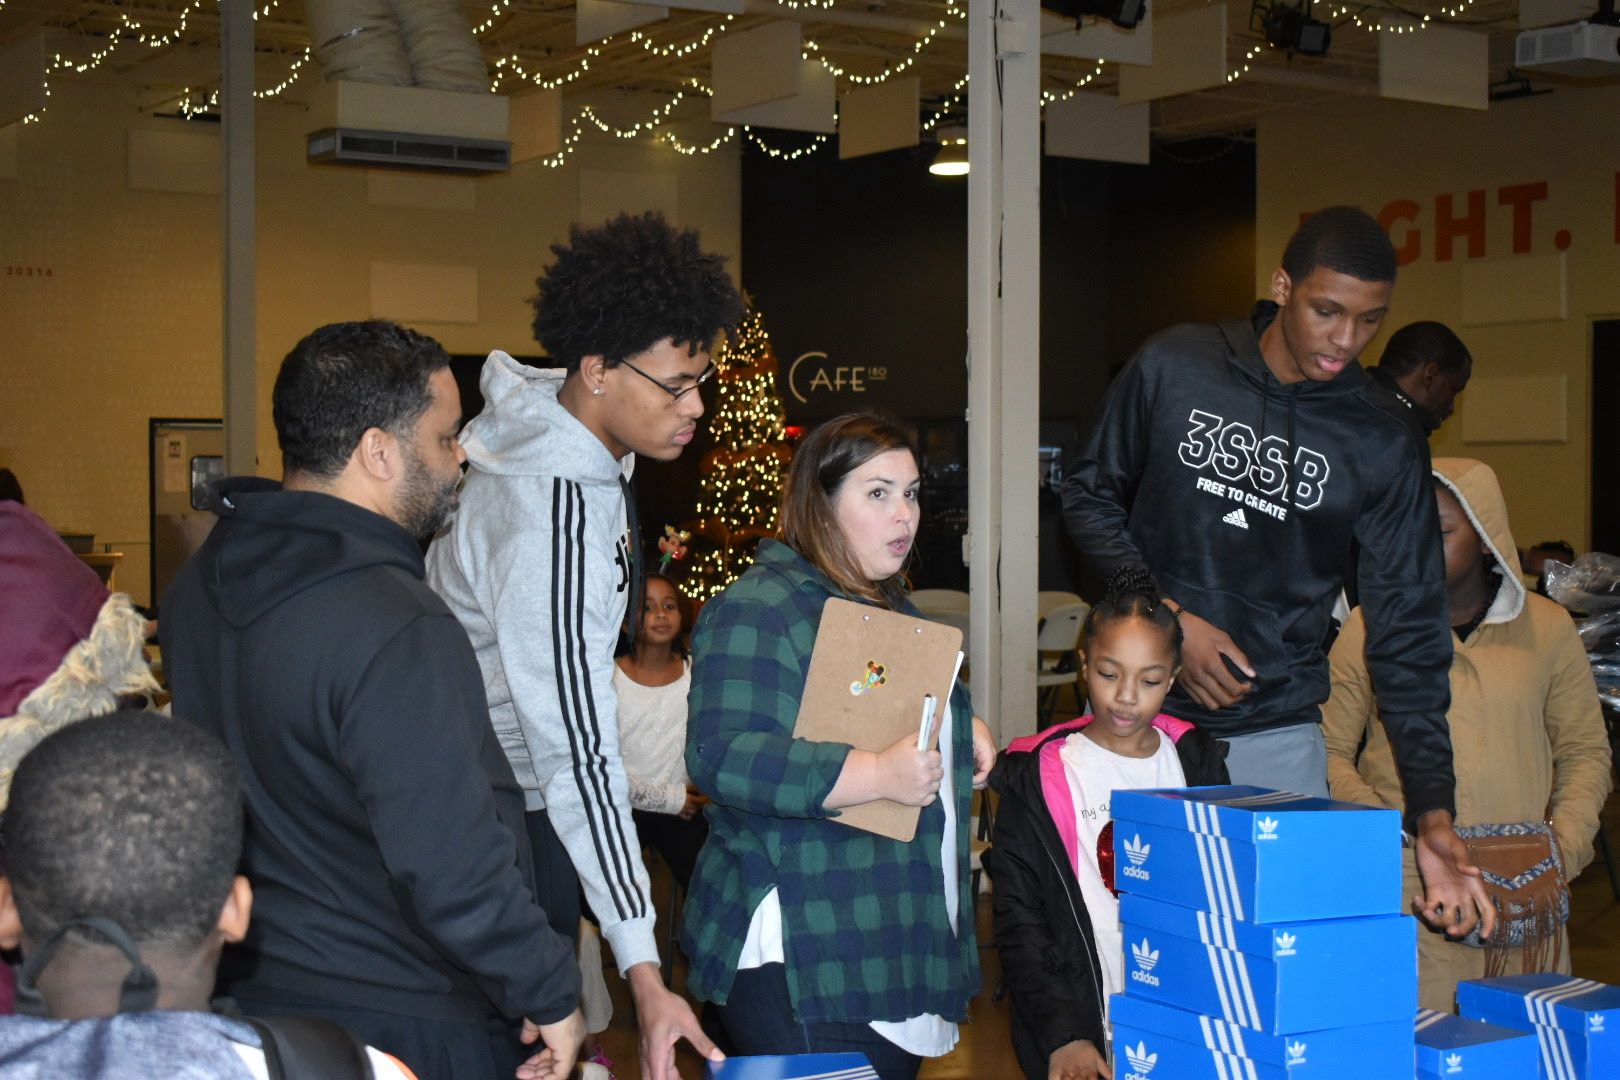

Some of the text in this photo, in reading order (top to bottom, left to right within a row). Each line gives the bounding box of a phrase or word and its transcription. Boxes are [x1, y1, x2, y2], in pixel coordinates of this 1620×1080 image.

[1299, 181, 1571, 268] GHT.
[789, 351, 866, 404] CAFE
[1178, 409, 1330, 510] 3SSB
[1196, 476, 1287, 521] FREE TO CREATE
[1222, 515, 1249, 530] adidas
[1080, 807, 1097, 820] my
[1123, 866, 1151, 881] adidas
[1131, 969, 1160, 987] adidas
